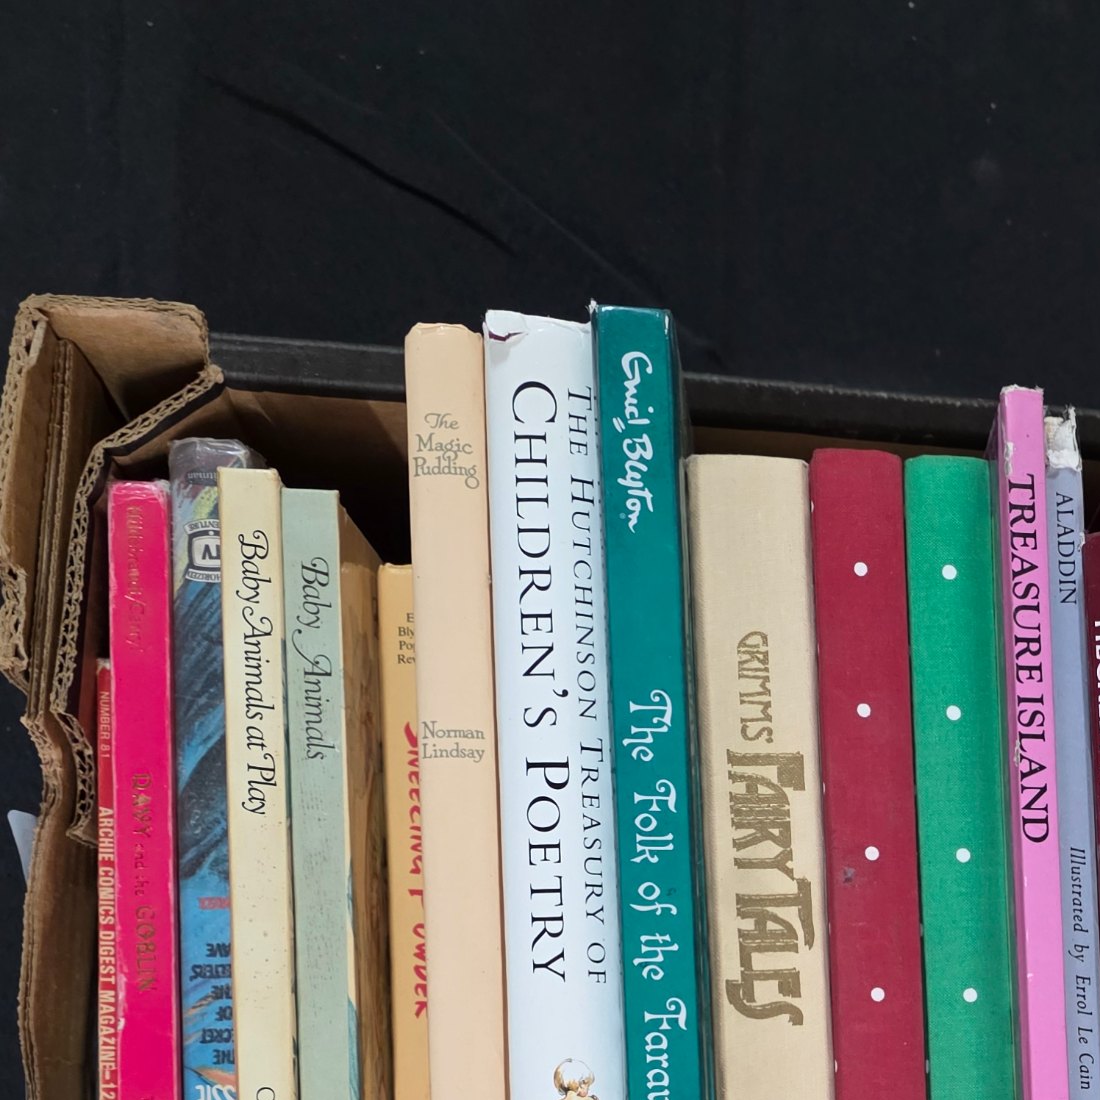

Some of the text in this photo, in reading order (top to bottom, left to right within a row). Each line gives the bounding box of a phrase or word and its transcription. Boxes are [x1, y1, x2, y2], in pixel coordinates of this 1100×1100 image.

[415, 432, 474, 461] Magic
[424, 412, 460, 430] The
[613, 350, 656, 533] Enid Blyton
[412, 455, 480, 490] Pudding
[1055, 491, 1078, 605] ALADDIN
[236, 529, 277, 815] Baby Animals at Play
[291, 557, 336, 761] Baby Animals
[511, 380, 571, 983] CHILDREN'S POETRY
[567, 386, 607, 985] THE HUTCHINSON TREASURY OF
[1007, 473, 1051, 844] TREASURE ISLAND
[99, 691, 112, 758] NUMBER 81
[421, 720, 486, 740] Norman
[422, 742, 486, 763] Lindsay
[623, 690, 674, 762] The
[99, 806, 115, 861] ARCHIE
[631, 779, 678, 865] Folk
[725, 631, 816, 1027] GRIMMS' FAIRY TALES
[99, 866, 115, 924] COMICS
[132, 773, 160, 992] DAVY GOBLIN
[628, 881, 678, 916] of
[99, 930, 115, 985] DIGEST
[632, 932, 680, 981] the
[1066, 846, 1095, 1091] Illustrated by Errol Le Cain
